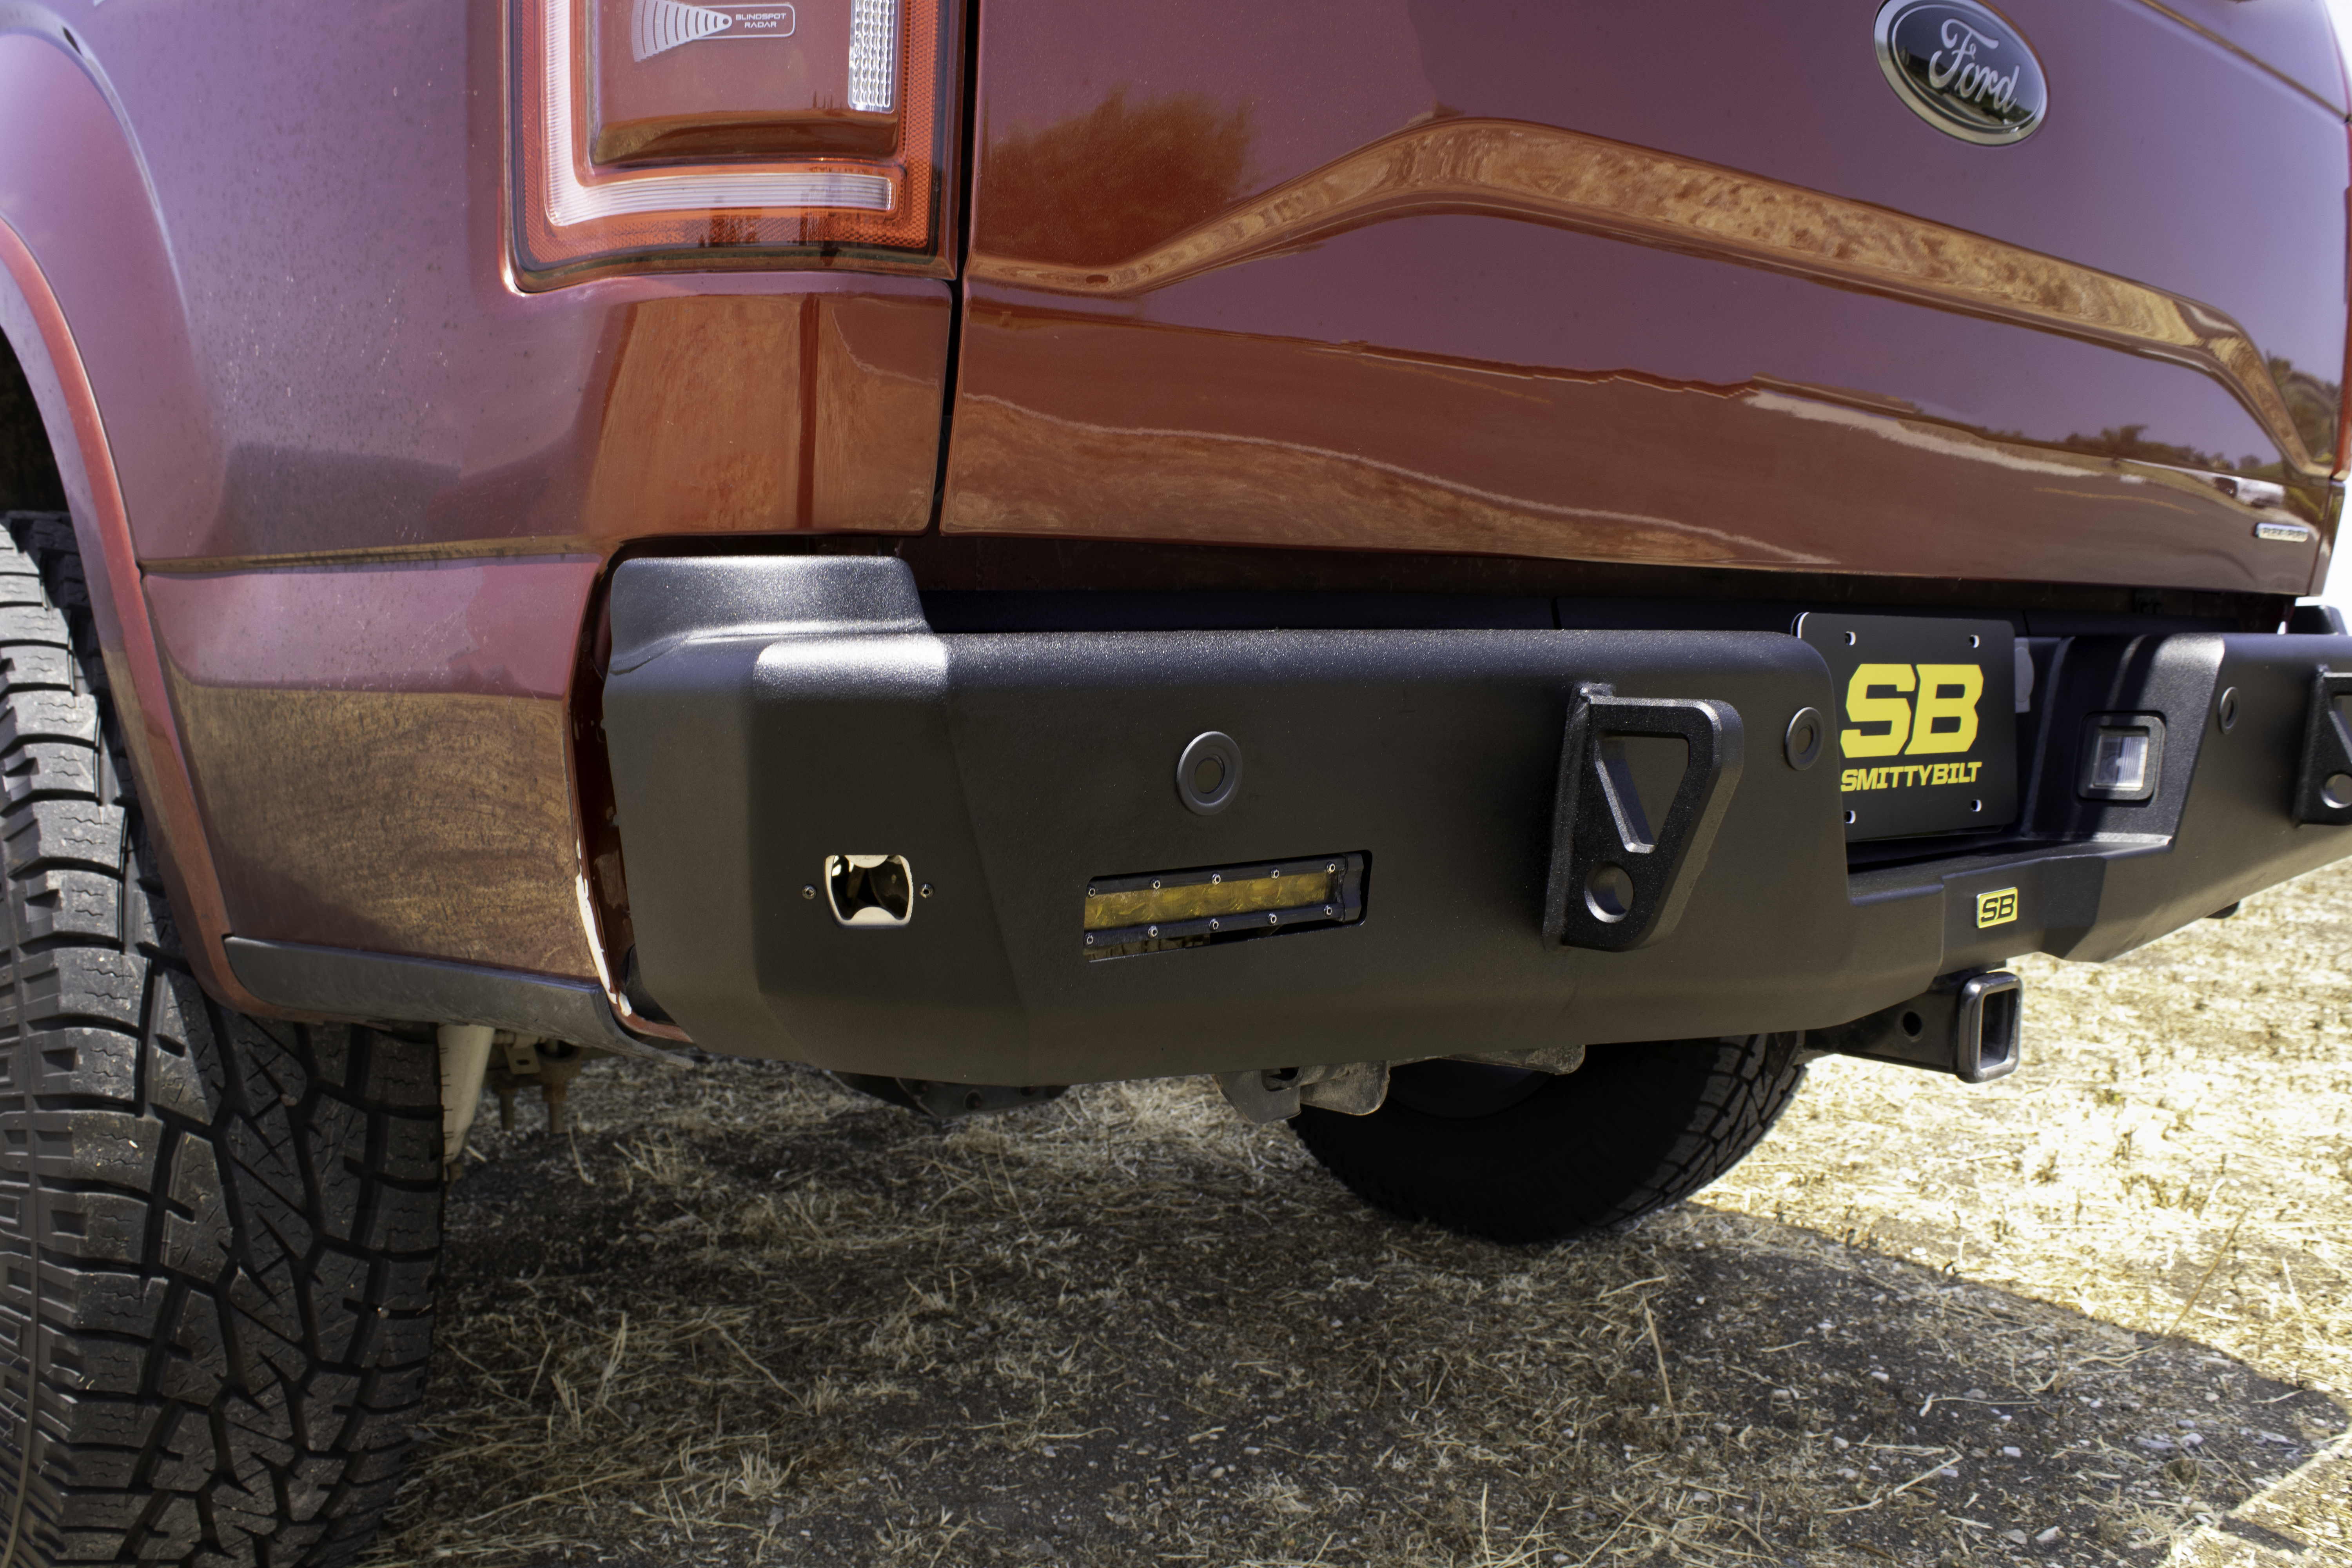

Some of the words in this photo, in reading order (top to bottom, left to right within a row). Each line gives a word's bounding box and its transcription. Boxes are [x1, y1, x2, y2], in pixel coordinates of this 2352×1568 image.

[1929, 18, 2020, 113] Ford
[1840, 664, 1984, 758] SB
[1841, 762, 1982, 791] SMITTYBILT
[1981, 894, 2015, 922] SB
